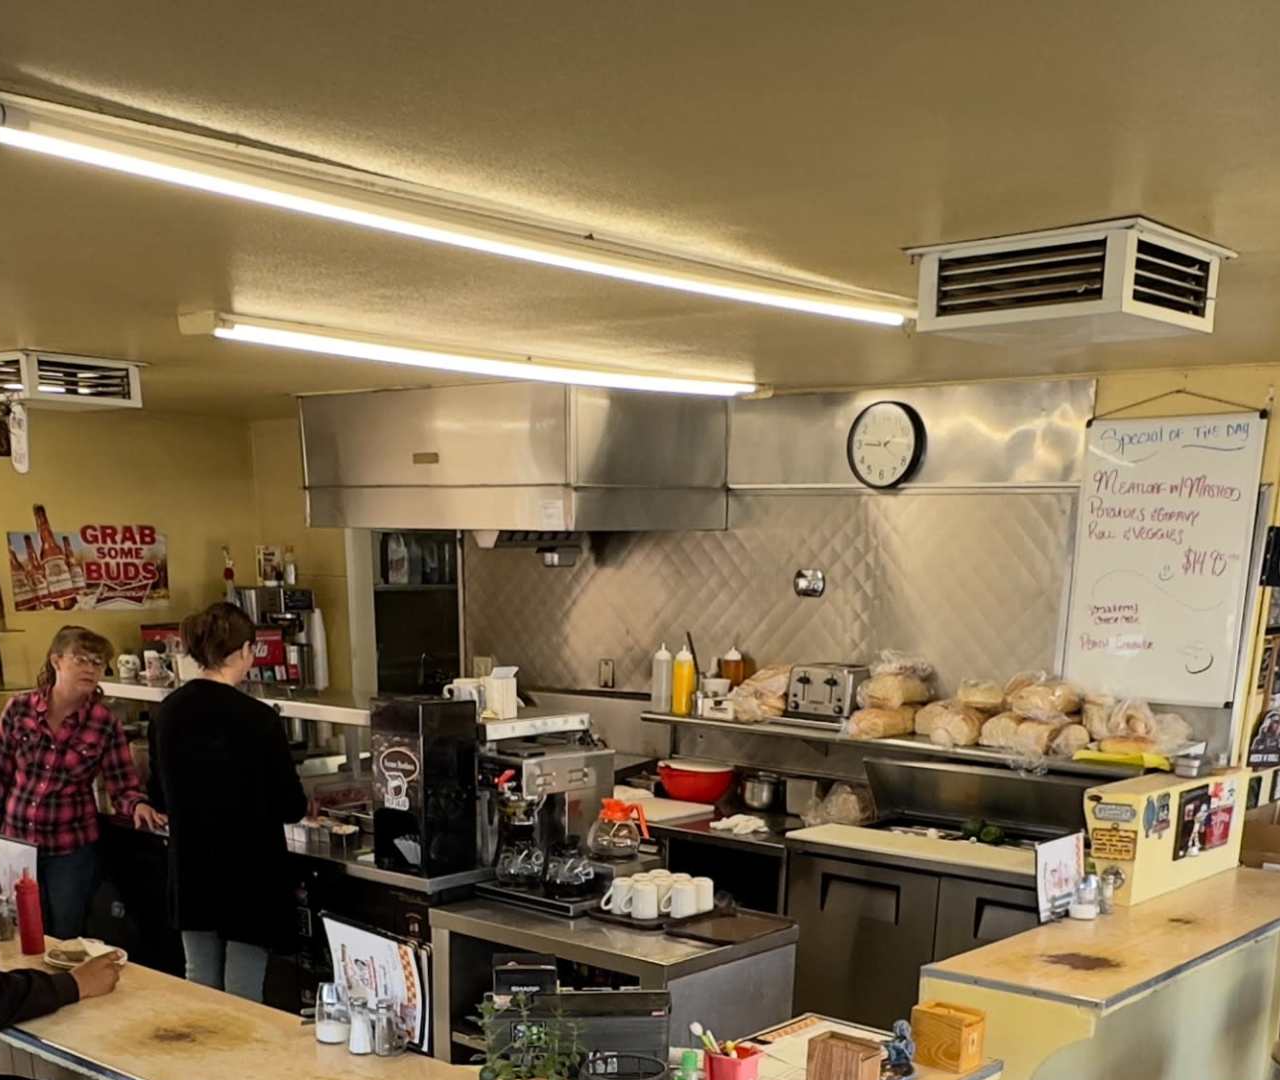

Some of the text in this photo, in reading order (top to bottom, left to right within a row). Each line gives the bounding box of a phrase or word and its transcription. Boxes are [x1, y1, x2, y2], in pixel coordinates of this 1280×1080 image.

[79, 524, 157, 546] GRAB
[96, 547, 145, 560] SOME
[84, 561, 159, 582] BUDS
[510, 985, 541, 993] SHARP
